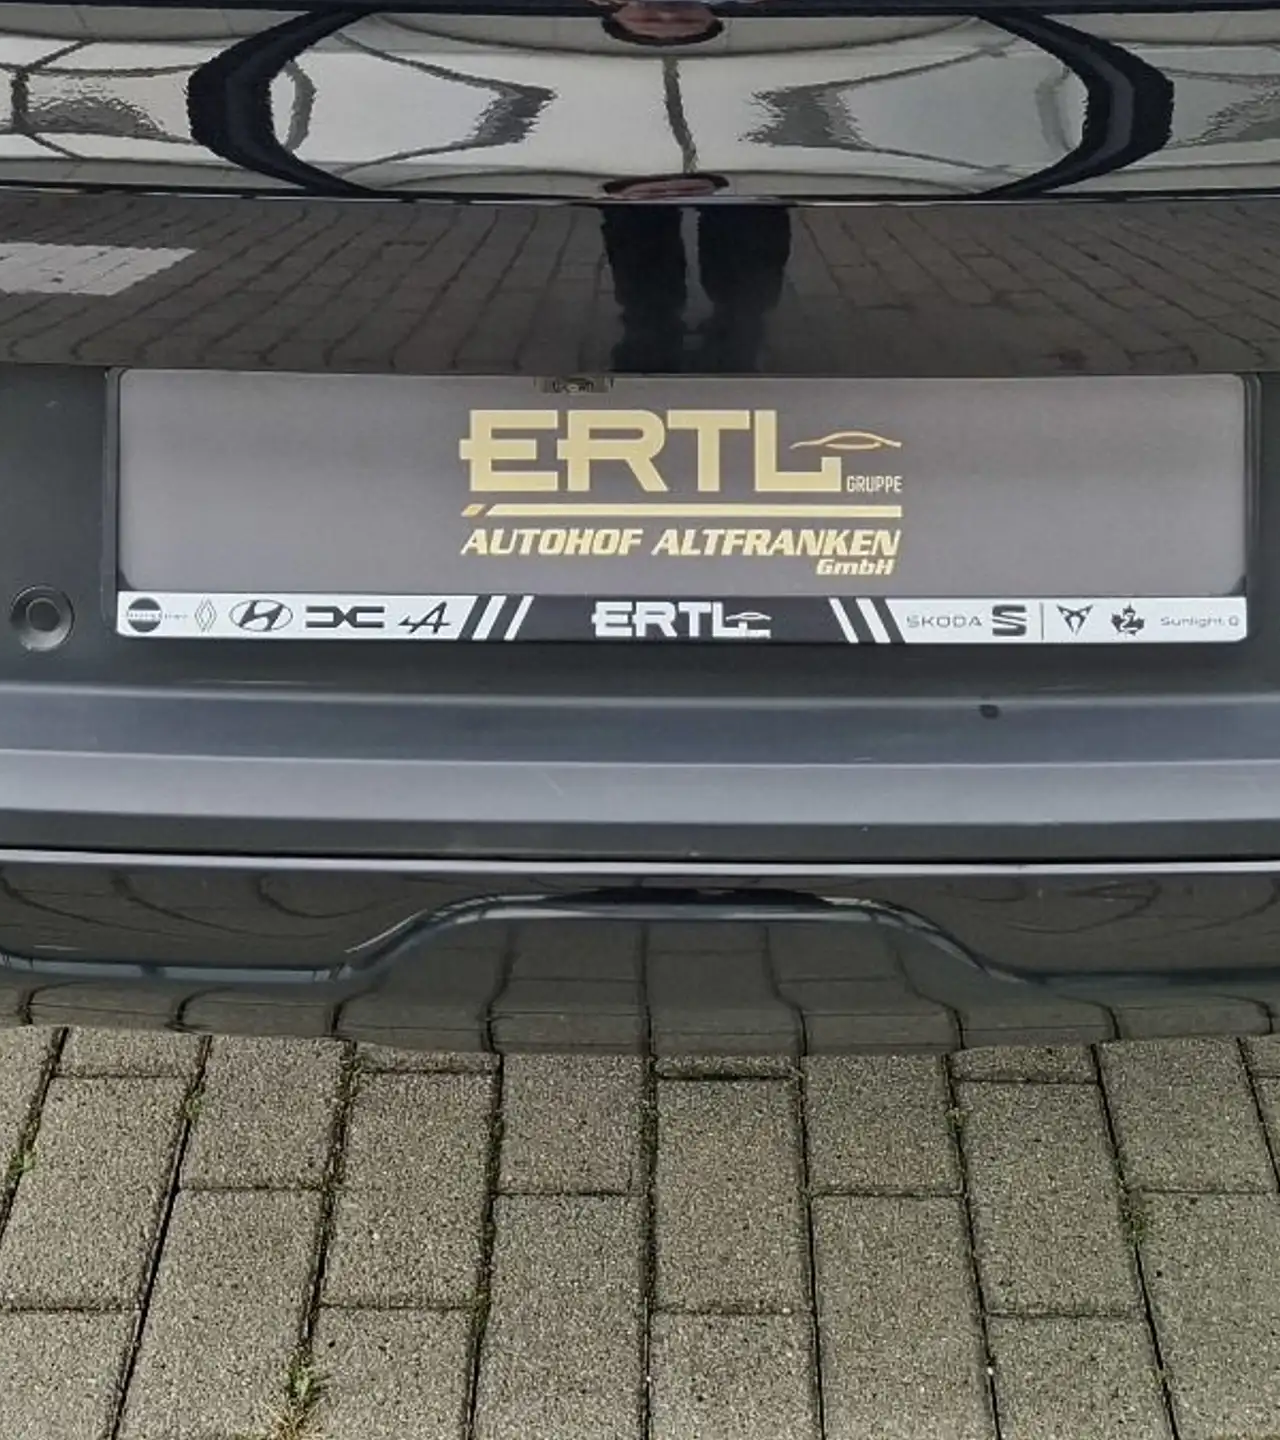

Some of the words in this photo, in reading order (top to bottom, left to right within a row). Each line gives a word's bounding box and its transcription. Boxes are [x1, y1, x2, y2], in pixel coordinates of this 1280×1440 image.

[459, 410, 842, 492] ERTL
[846, 475, 903, 493] GRUPPE
[460, 528, 644, 555] AUTOHOF
[651, 528, 902, 557] ALTFRANKEN
[816, 558, 895, 576] GmbH
[591, 601, 771, 638] ERTL
